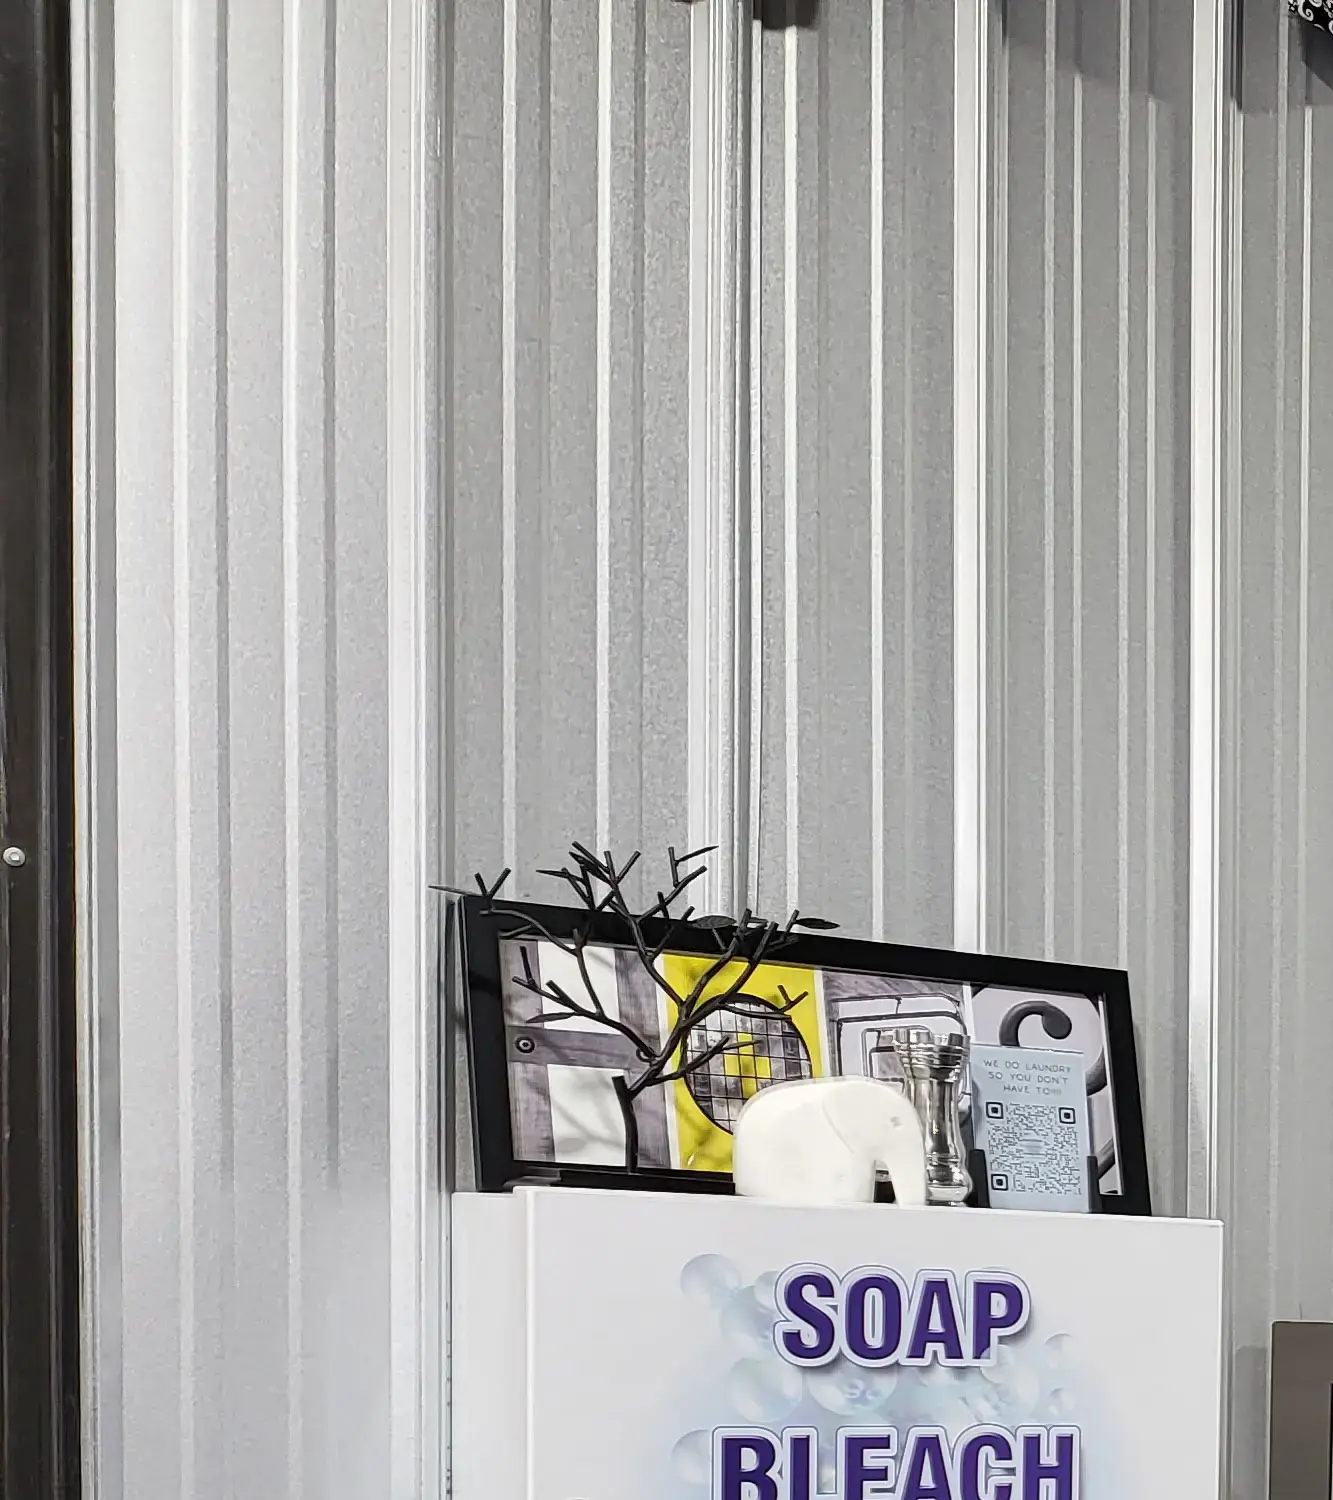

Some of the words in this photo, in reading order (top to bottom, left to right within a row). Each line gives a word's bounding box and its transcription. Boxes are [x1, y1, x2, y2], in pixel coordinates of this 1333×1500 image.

[983, 1059, 999, 1068] WE
[1005, 1060, 1020, 1069] DO
[1025, 1062, 1071, 1073] LAUNDRY
[988, 1071, 1003, 1080] SO
[1010, 1073, 1031, 1082] YOU
[1037, 1075, 1069, 1085] DON'T
[1003, 1084, 1030, 1094] HAVE
[778, 1266, 1028, 1366] SOAP
